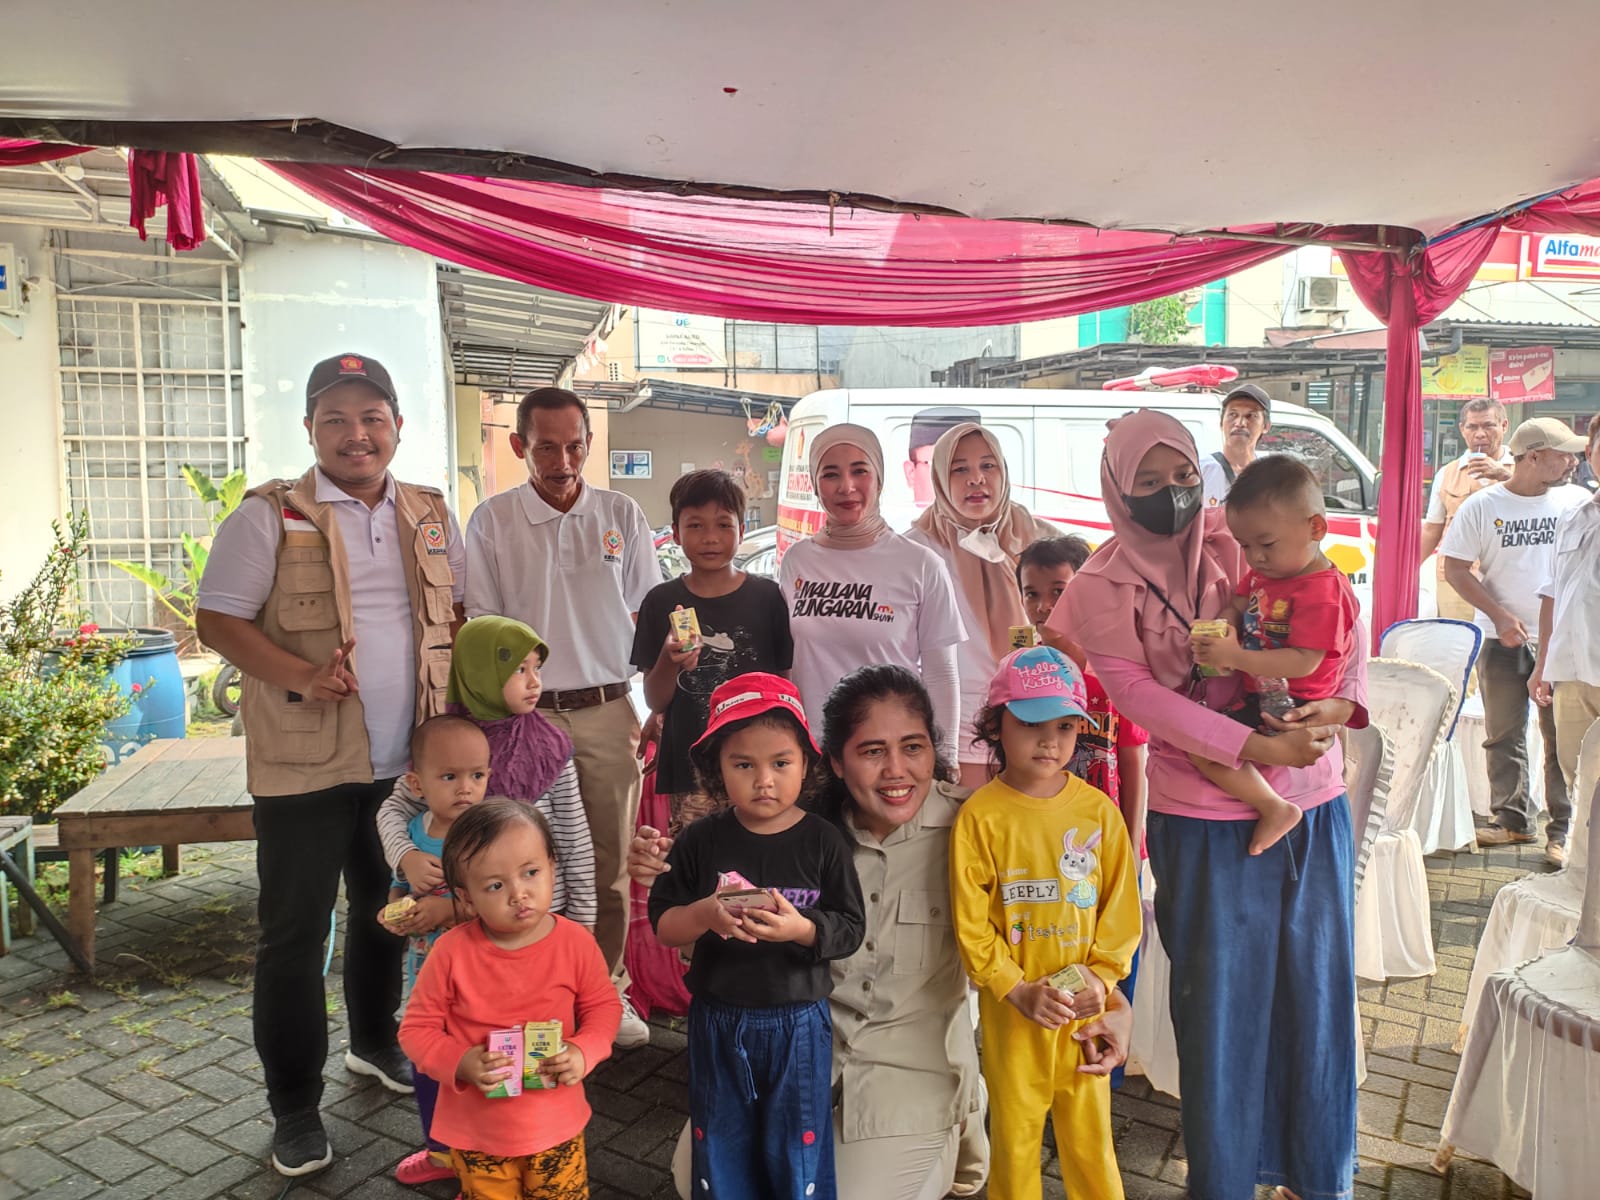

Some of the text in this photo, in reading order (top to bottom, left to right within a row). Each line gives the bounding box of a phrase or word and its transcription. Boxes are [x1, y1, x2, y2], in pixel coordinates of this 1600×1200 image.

[800, 580, 873, 600] MAULANA
[792, 598, 878, 620] BUNGARAN
[1018, 661, 1060, 678] Hello
[1022, 674, 1064, 692] Kitty
